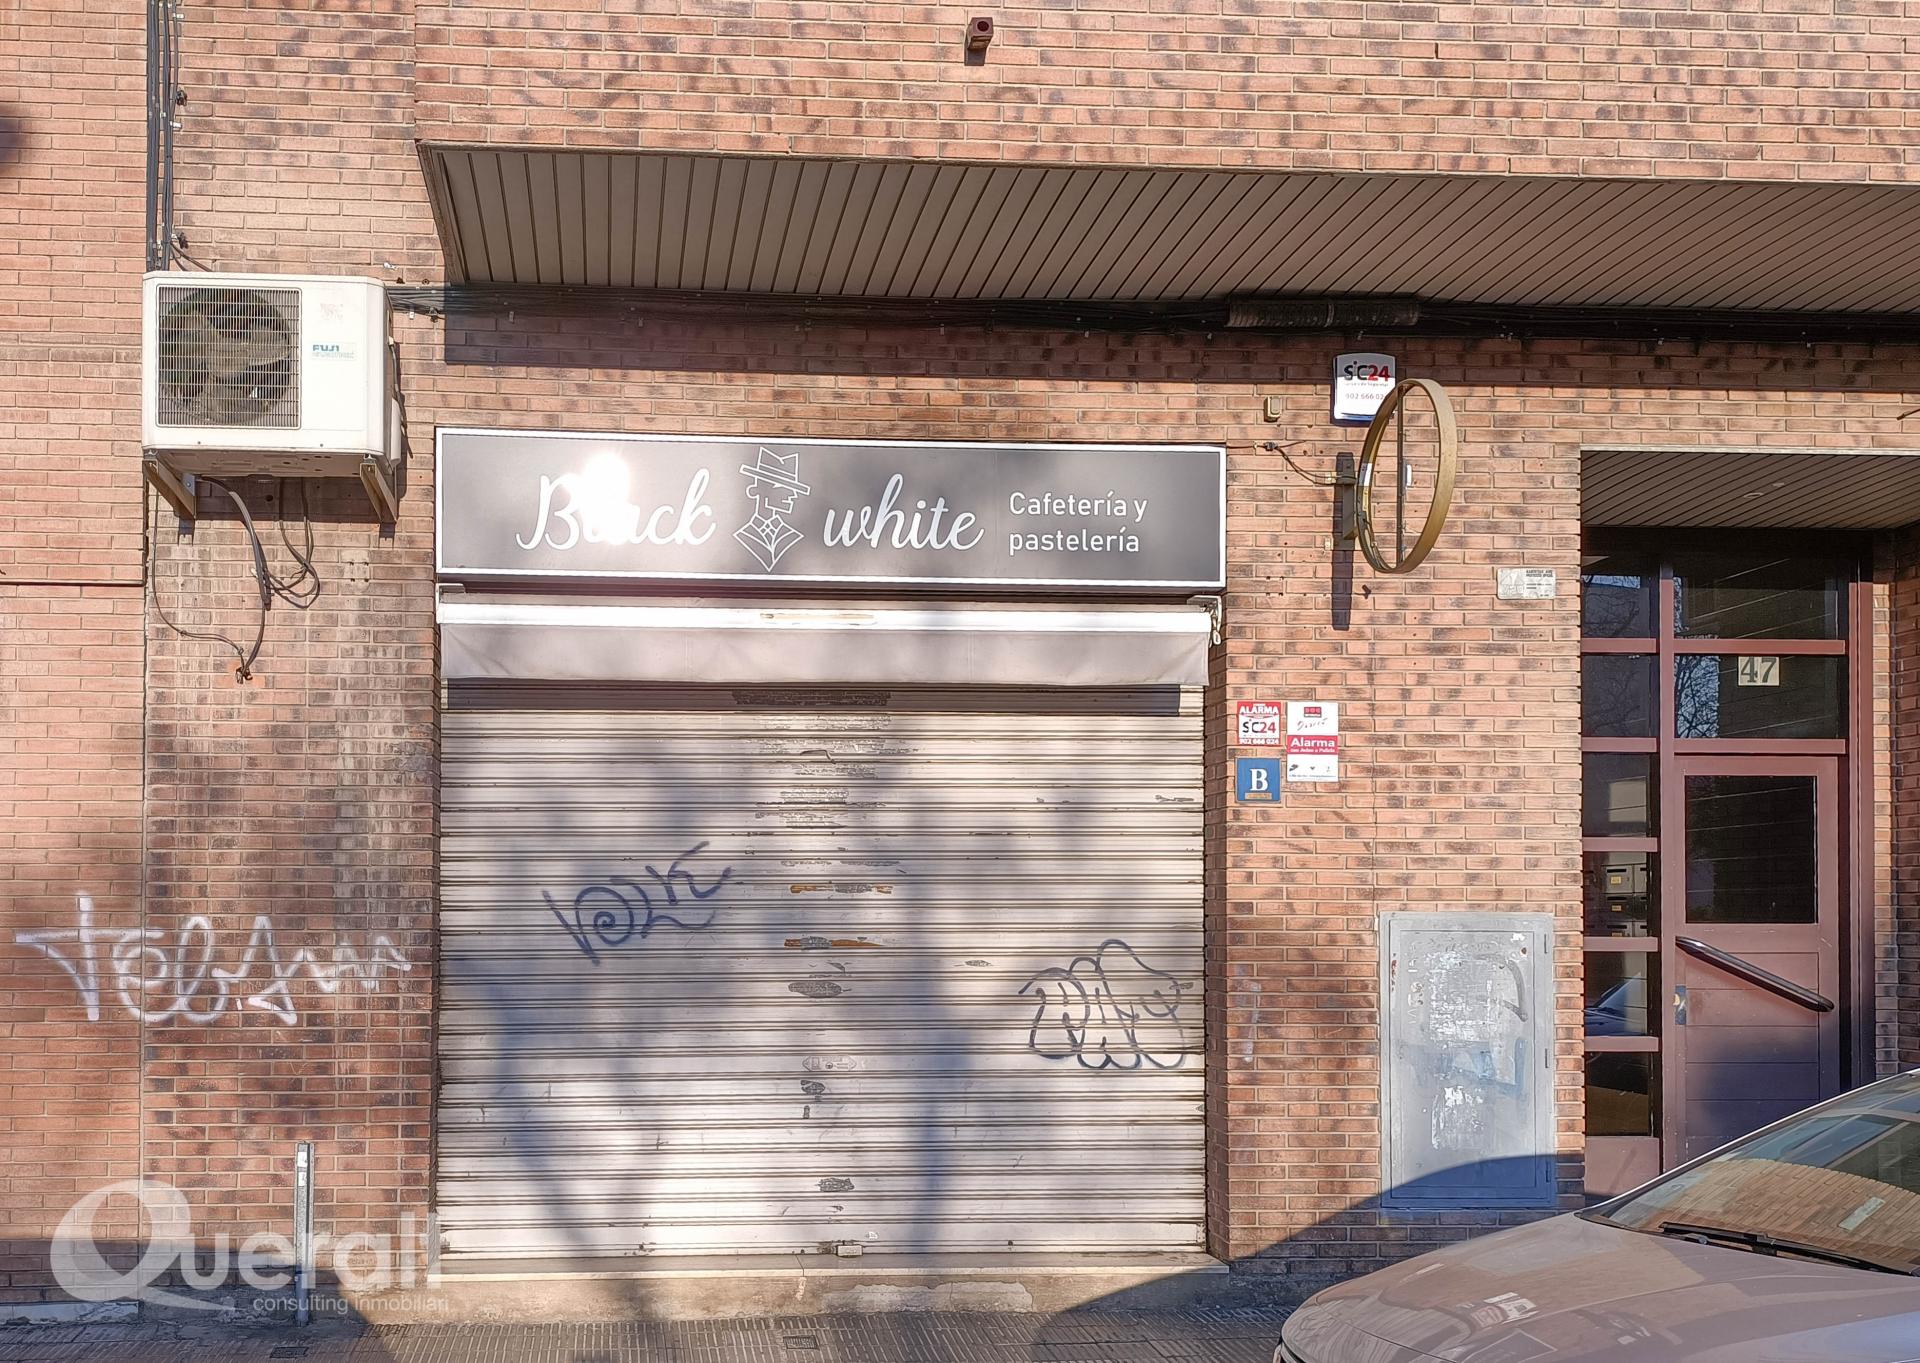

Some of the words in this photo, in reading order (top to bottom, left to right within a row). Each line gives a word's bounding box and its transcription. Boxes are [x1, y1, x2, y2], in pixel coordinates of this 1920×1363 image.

[312, 344, 340, 352] FUJI
[515, 468, 717, 550] Bck
[823, 473, 985, 551] white
[1009, 490, 1128, 517] Cafetería
[1133, 499, 1149, 523] y
[1009, 526, 1140, 557] pastelería
[1740, 656, 1777, 684] 47
[1239, 704, 1280, 715] ALARMA
[1290, 736, 1336, 748] Alarma
[1249, 768, 1269, 791] B
